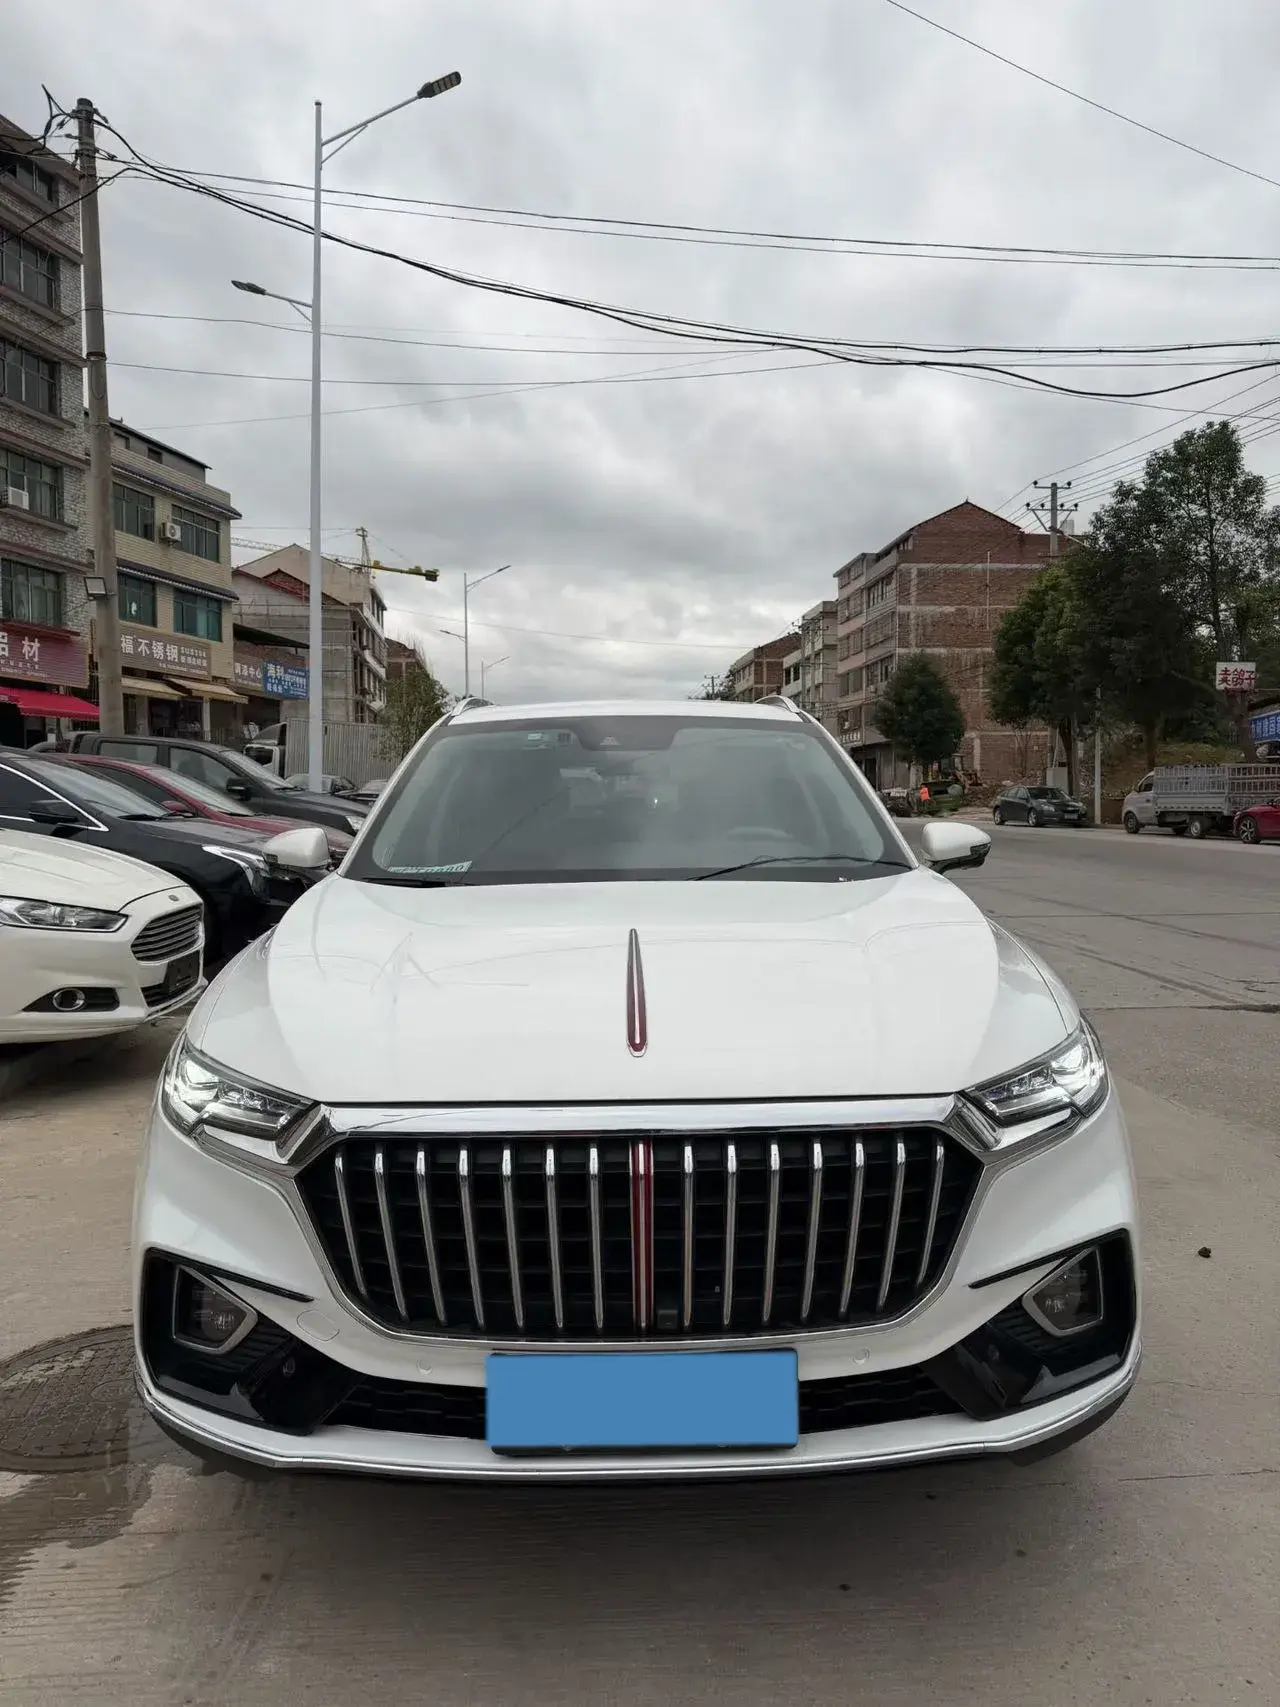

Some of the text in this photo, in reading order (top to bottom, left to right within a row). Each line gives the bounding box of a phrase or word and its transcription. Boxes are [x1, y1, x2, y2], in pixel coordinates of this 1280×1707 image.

[121, 634, 178, 662] 福不锈钢
[1218, 667, 1257, 686] 卖鸽子
